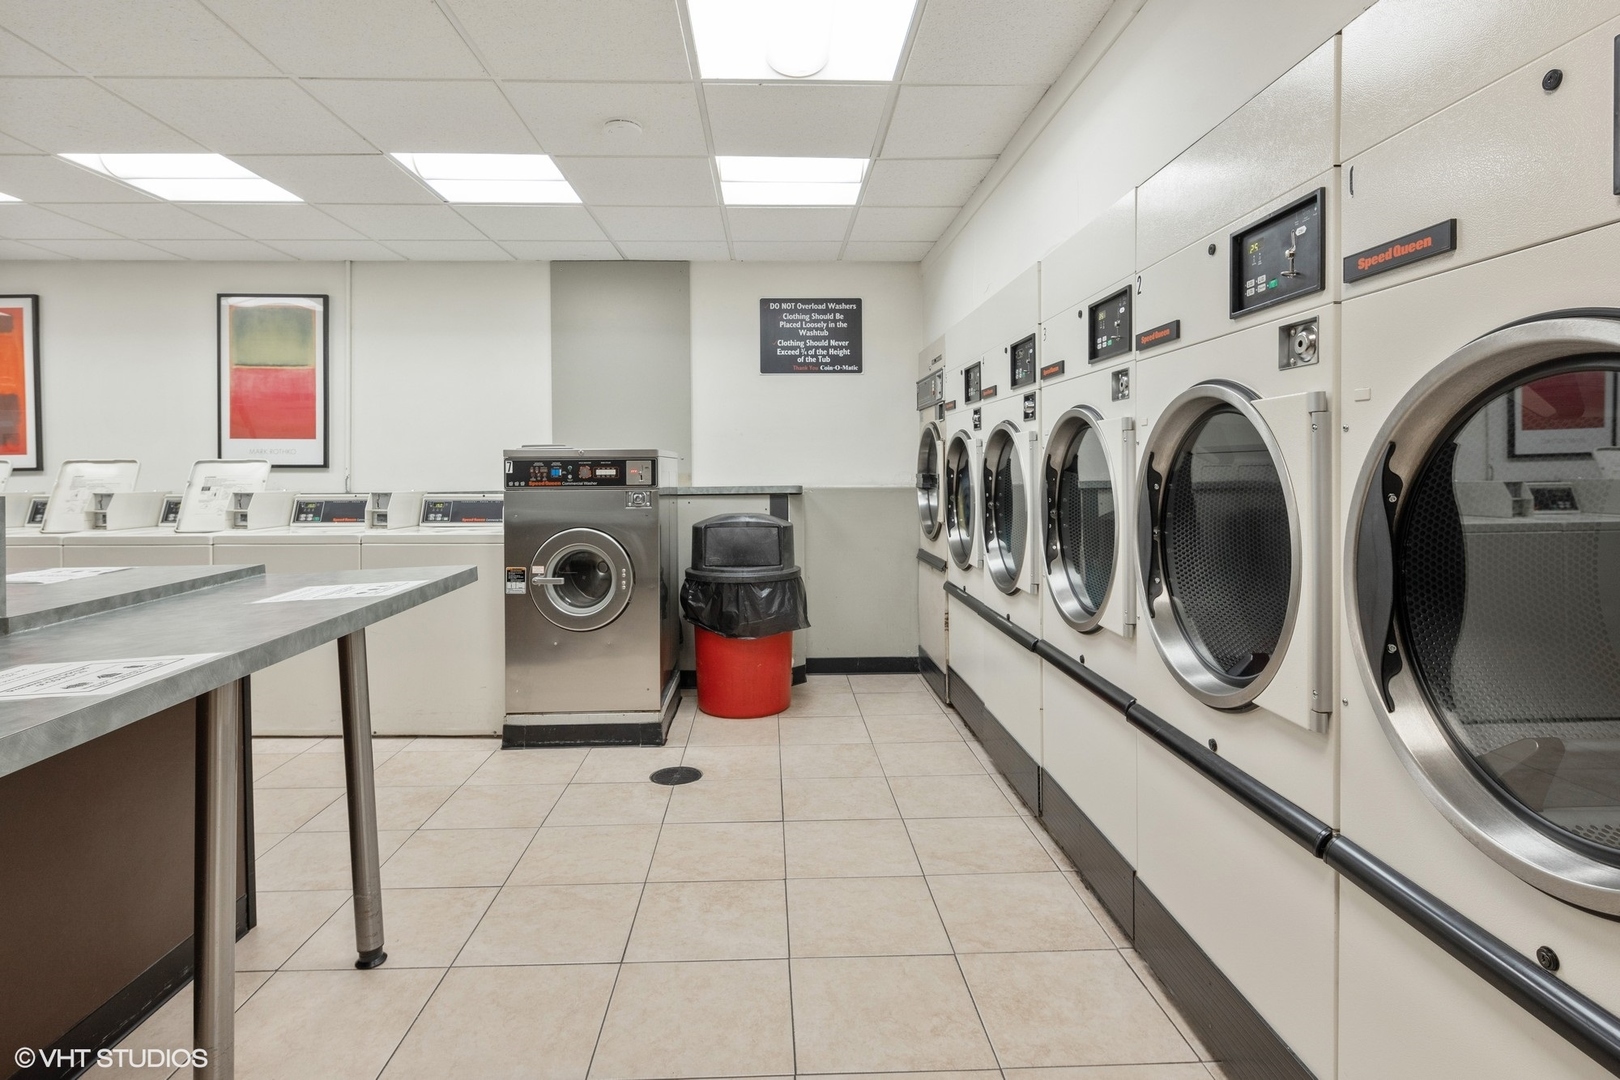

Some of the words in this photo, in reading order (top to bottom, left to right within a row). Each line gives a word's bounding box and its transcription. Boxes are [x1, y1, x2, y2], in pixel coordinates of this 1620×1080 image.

[1357, 247, 1393, 270] Speed
[1393, 236, 1433, 257] Queen
[1136, 276, 1142, 295] 2
[782, 313, 810, 321] Clothing
[802, 321, 827, 330] Loosely
[507, 462, 512, 473] 7
